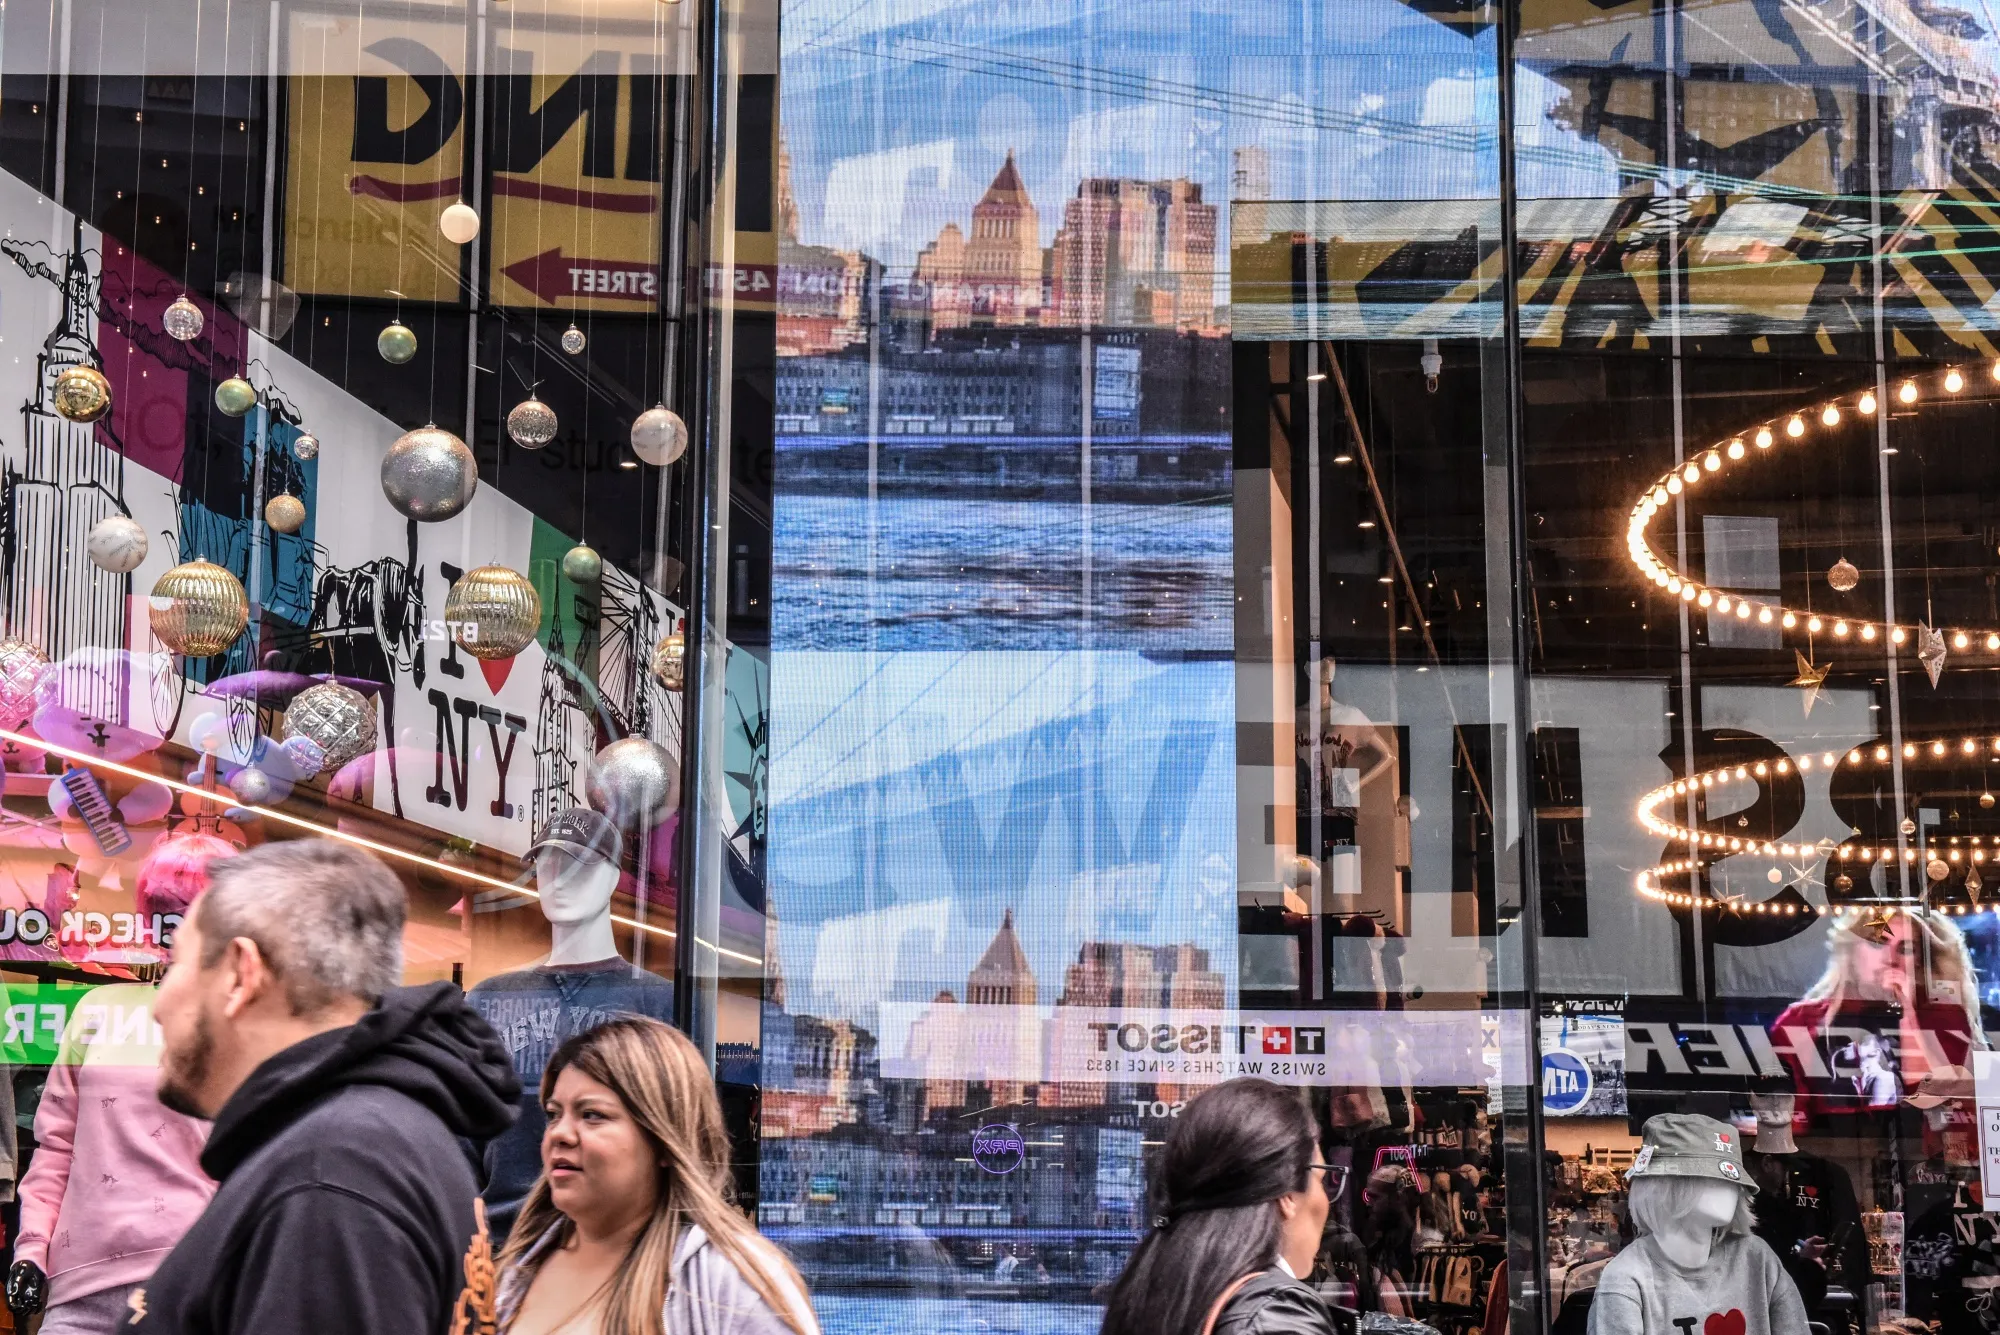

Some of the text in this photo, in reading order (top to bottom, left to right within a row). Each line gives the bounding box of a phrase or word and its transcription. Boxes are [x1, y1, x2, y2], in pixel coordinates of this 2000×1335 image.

[426, 688, 527, 819] NY
[1713, 1142, 1734, 1154] NY
[1796, 1195, 1819, 1209] NY
